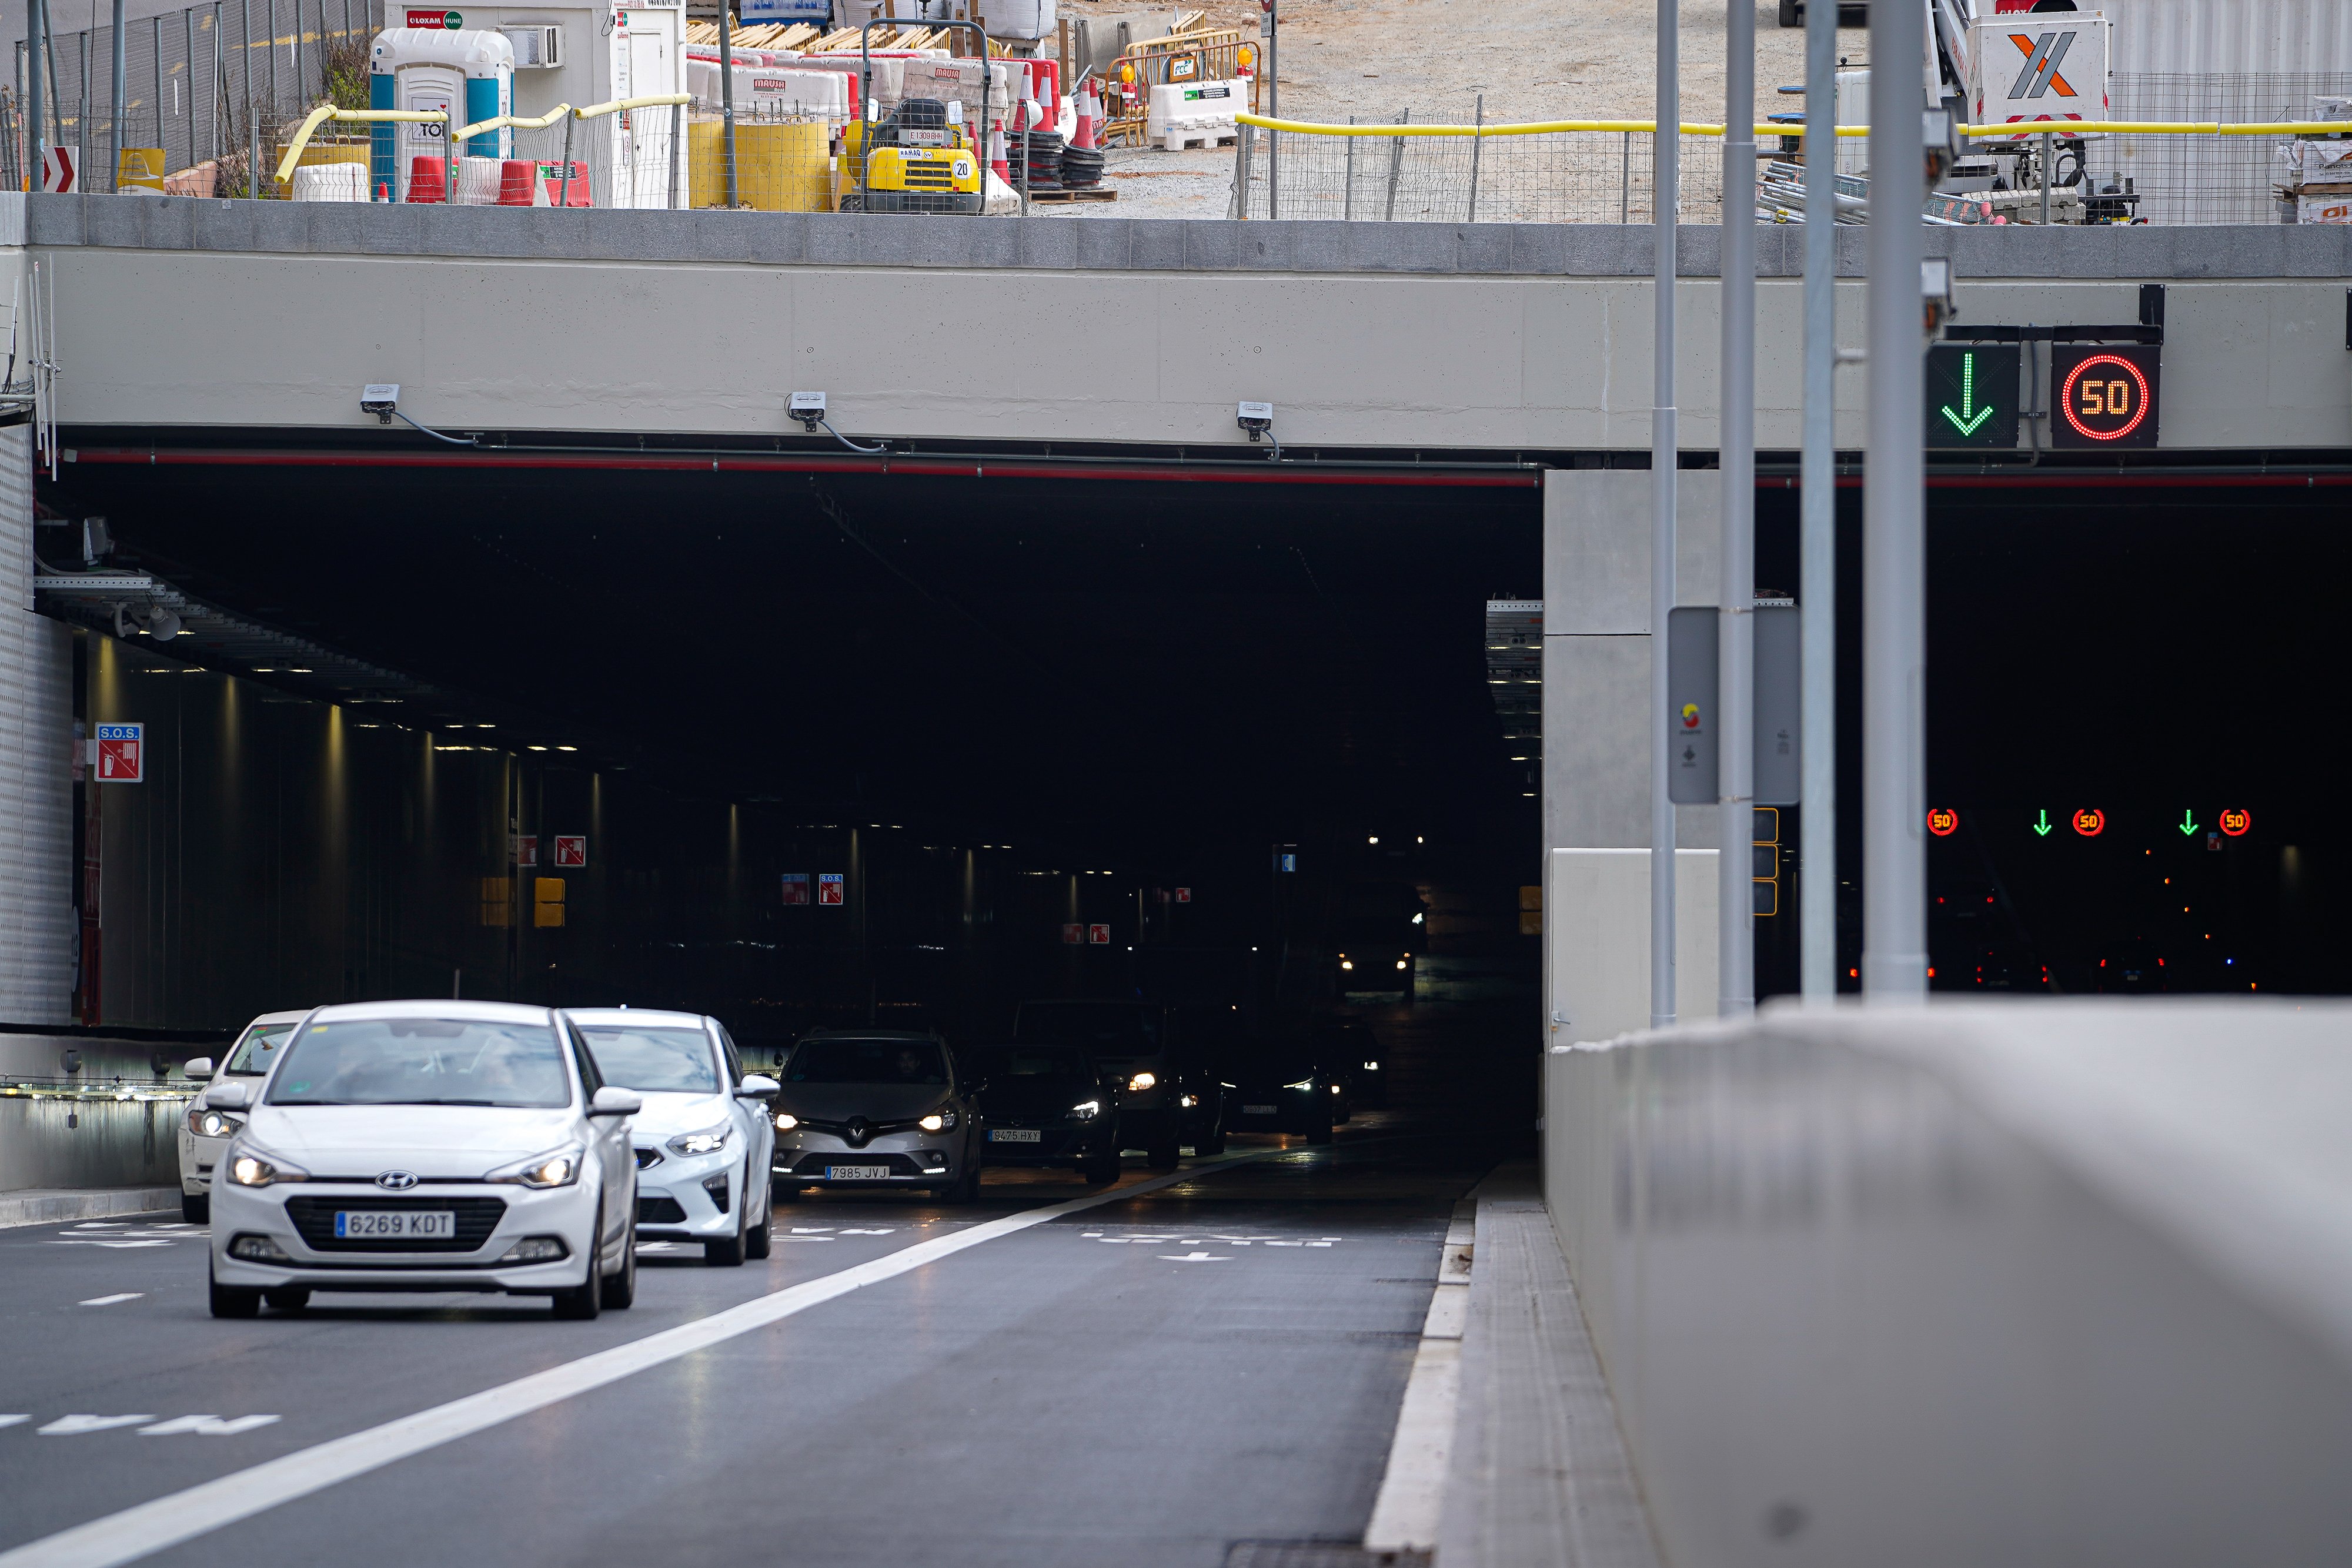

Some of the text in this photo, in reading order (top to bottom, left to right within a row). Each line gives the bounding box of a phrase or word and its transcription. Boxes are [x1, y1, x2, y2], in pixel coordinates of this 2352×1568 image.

[936, 69, 959, 78] MAUSA
[1175, 65, 1188, 75] FCC
[957, 163, 968, 175] 20
[2082, 380, 2128, 414] 50
[101, 728, 138, 738] S.O.S.
[1934, 814, 1951, 828] 50
[2080, 814, 2097, 828] 50
[2226, 814, 2244, 828] 50
[995, 1131, 1038, 1140] 9475 HXY
[833, 1168, 886, 1178] 7985 JVJ
[350, 1215, 449, 1233] 6269 KDT
